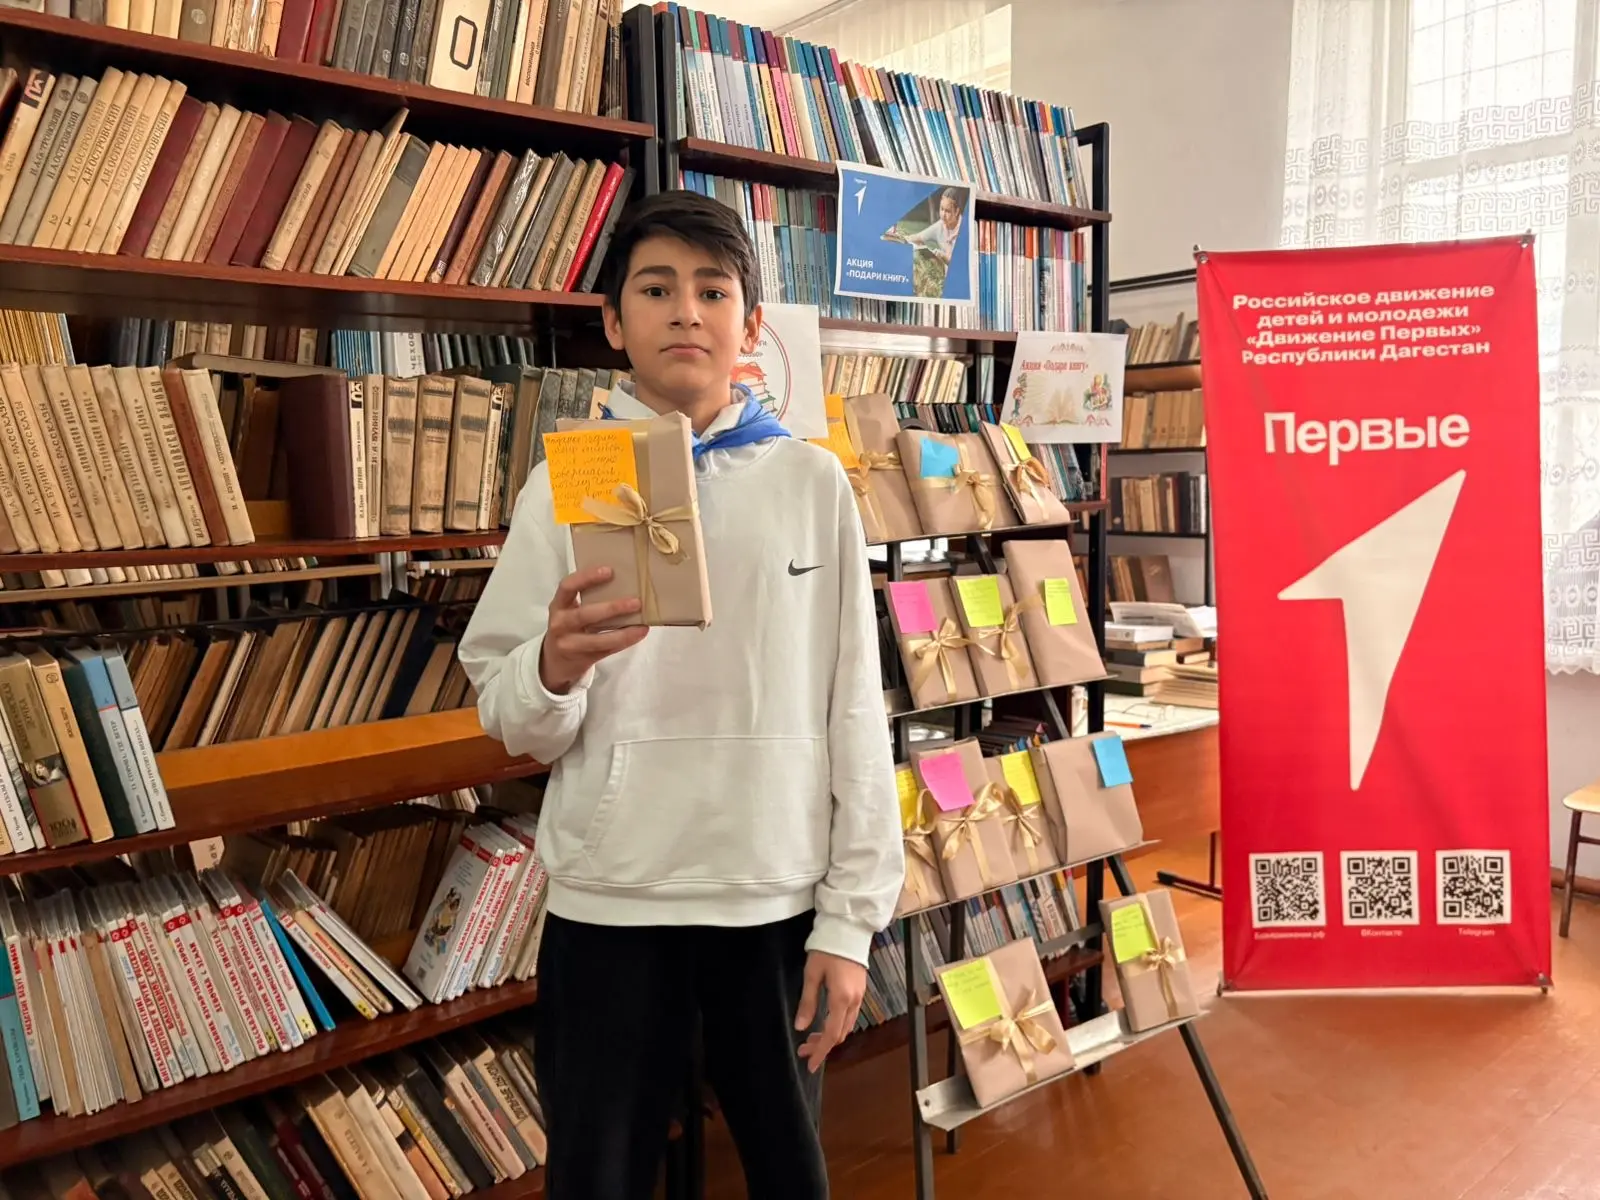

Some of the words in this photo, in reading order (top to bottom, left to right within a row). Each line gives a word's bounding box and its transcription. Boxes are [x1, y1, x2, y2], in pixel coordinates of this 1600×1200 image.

[846, 258, 874, 269] АКЦИЯ
[1232, 291, 1371, 310] Российское
[1375, 284, 1495, 305] движение
[1257, 310, 1324, 329] детей
[1328, 312, 1343, 325] и
[1347, 305, 1469, 325] молодежи
[1246, 328, 1376, 348] «Движение
[1380, 324, 1482, 342] Первых»
[1242, 347, 1376, 366] Республики
[1379, 341, 1490, 361] Дагестан
[1264, 411, 1471, 466] Первые
